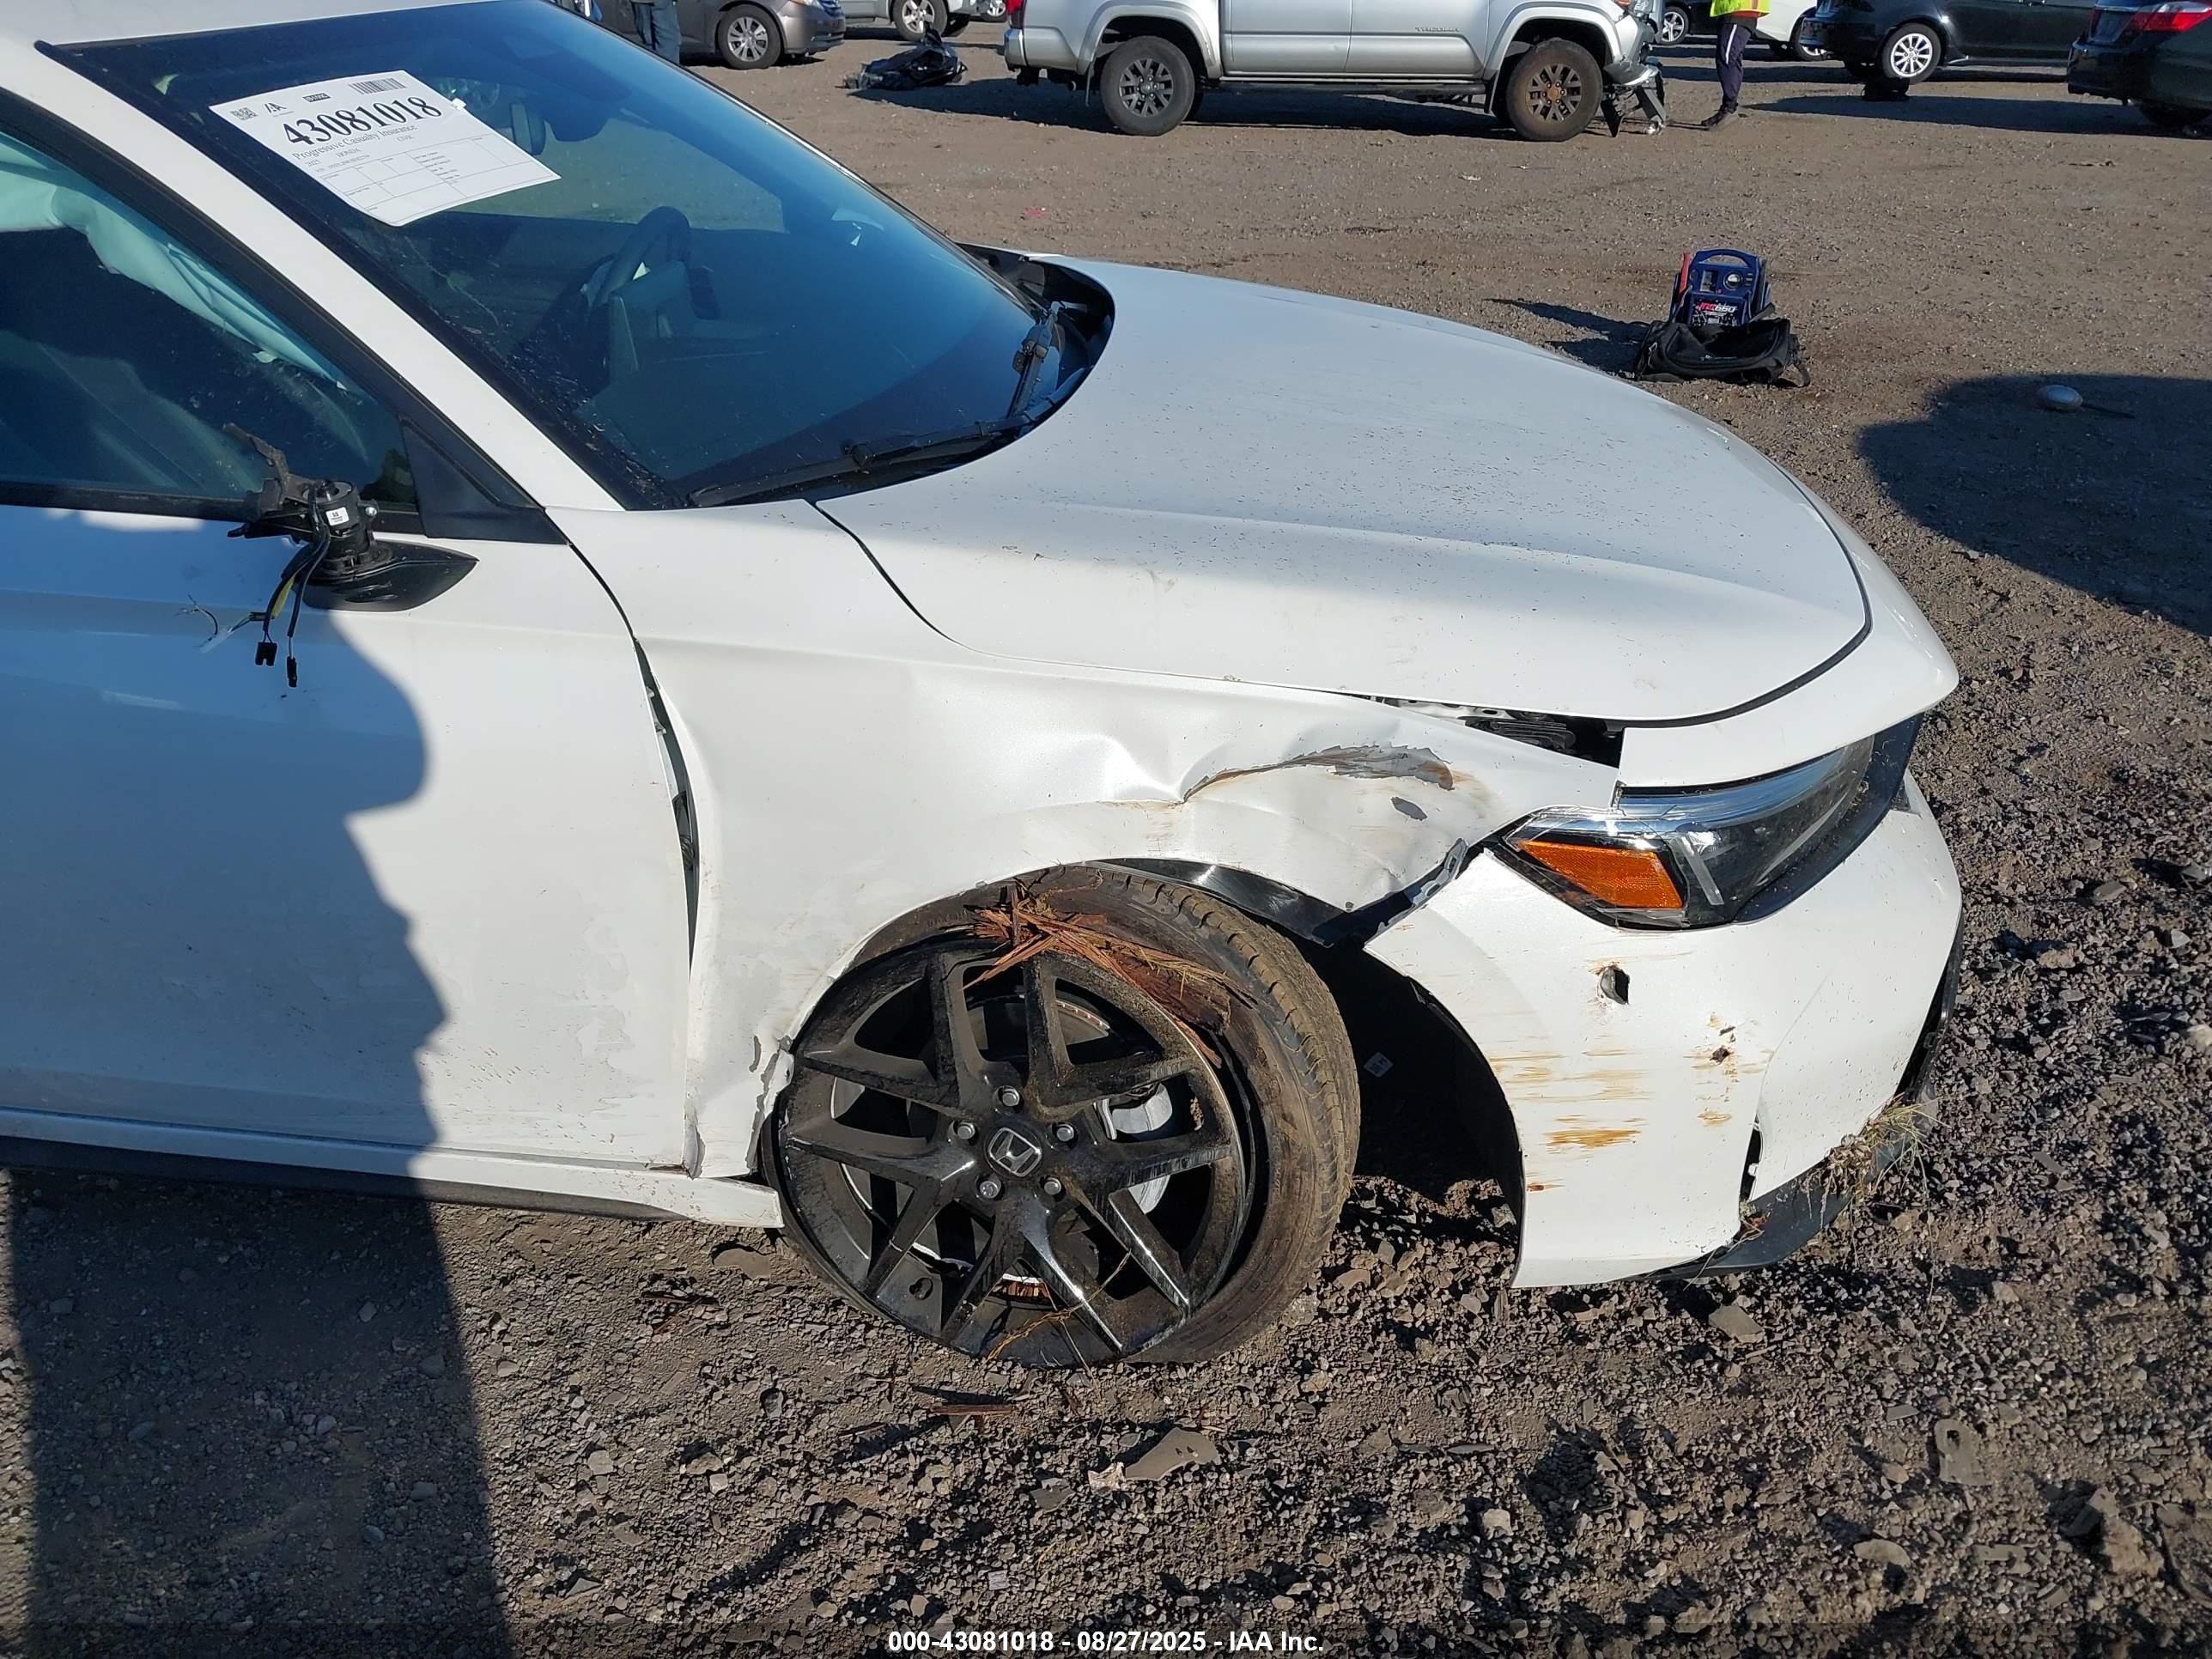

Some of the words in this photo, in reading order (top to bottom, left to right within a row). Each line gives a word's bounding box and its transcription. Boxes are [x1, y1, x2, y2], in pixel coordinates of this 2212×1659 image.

[283, 96, 442, 145] 43081018
[292, 138, 343, 160] Progressive
[343, 131, 380, 146] Casualty
[379, 125, 417, 137] Insurance
[336, 148, 362, 158] HONDA
